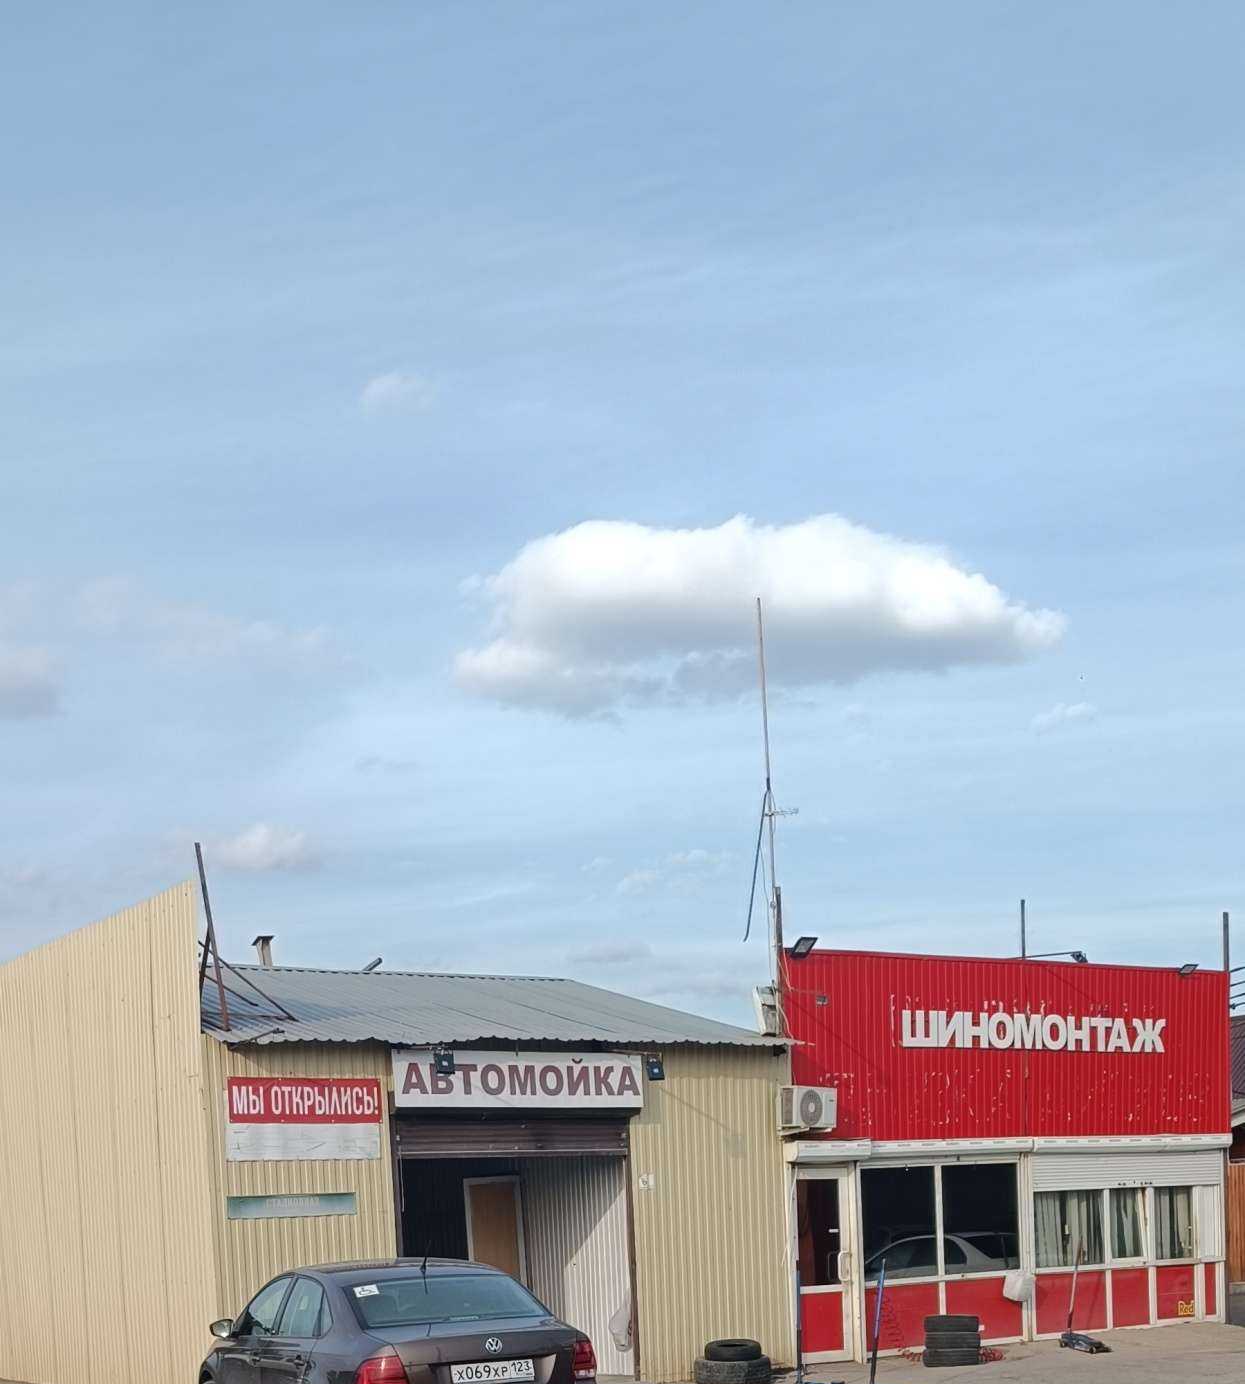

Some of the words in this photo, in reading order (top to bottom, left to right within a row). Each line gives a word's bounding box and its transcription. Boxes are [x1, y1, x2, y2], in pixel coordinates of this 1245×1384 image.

[902, 1009, 1166, 1053] ШИНОМОНТАЖ
[402, 1058, 641, 1097] АВТОМОЙКА
[232, 1085, 264, 1115] МЫ
[271, 1086, 379, 1115] ОТКРЫЛИСЬ!
